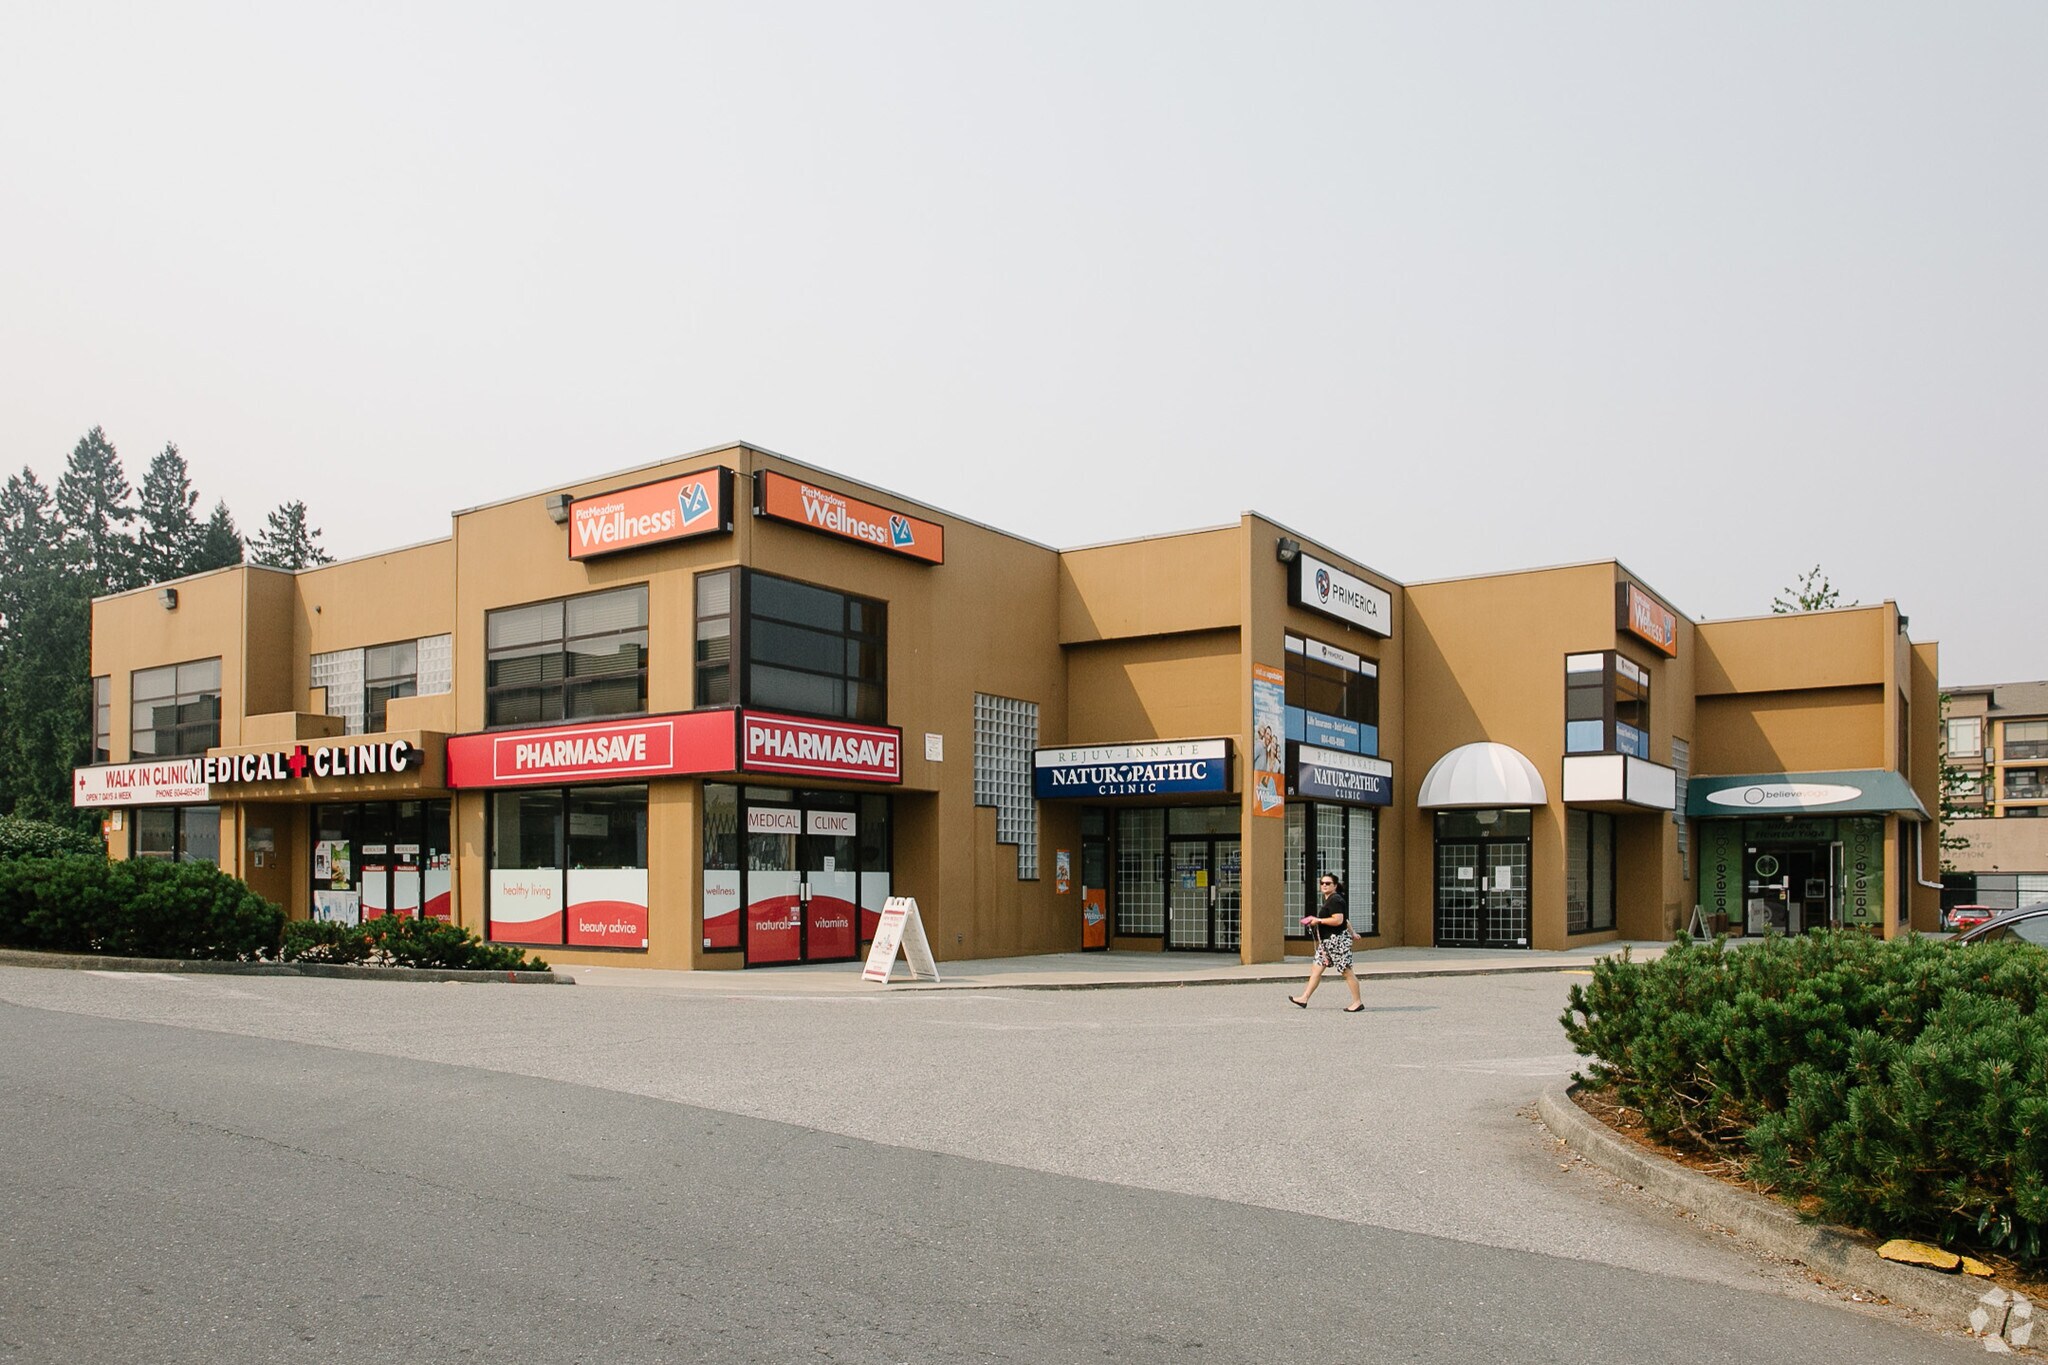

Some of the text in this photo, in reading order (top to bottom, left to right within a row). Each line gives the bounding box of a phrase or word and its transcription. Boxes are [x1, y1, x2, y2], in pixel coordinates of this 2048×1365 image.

[801, 485, 846, 507] PittMeadows
[576, 503, 624, 520] PittMeadows
[802, 496, 885, 543] Wellness
[577, 510, 671, 547] Wellness
[1333, 584, 1377, 617] PRIMERICA
[516, 734, 647, 769] PHARMASAVE
[750, 727, 895, 768] PHARMASAVE
[1058, 744, 1199, 763] REJUV-INNATE
[187, 740, 407, 783] MEDICAL CLINIC
[105, 769, 136, 788] WALK
[139, 768, 150, 786] IN
[86, 793, 98, 801] OPEN
[102, 792, 114, 800] DAYS
[118, 791, 132, 799] WEEK
[156, 789, 173, 797] PHONE
[1099, 783, 1156, 795] CLINIC
[1335, 789, 1360, 800] CLINIC
[748, 813, 848, 830] MEDICAL CLINIC
[503, 883, 551, 900] healthy living
[706, 885, 735, 895] wellness
[579, 918, 636, 936] beauty advice
[756, 916, 792, 931] naturals
[815, 917, 848, 928] vitamins
